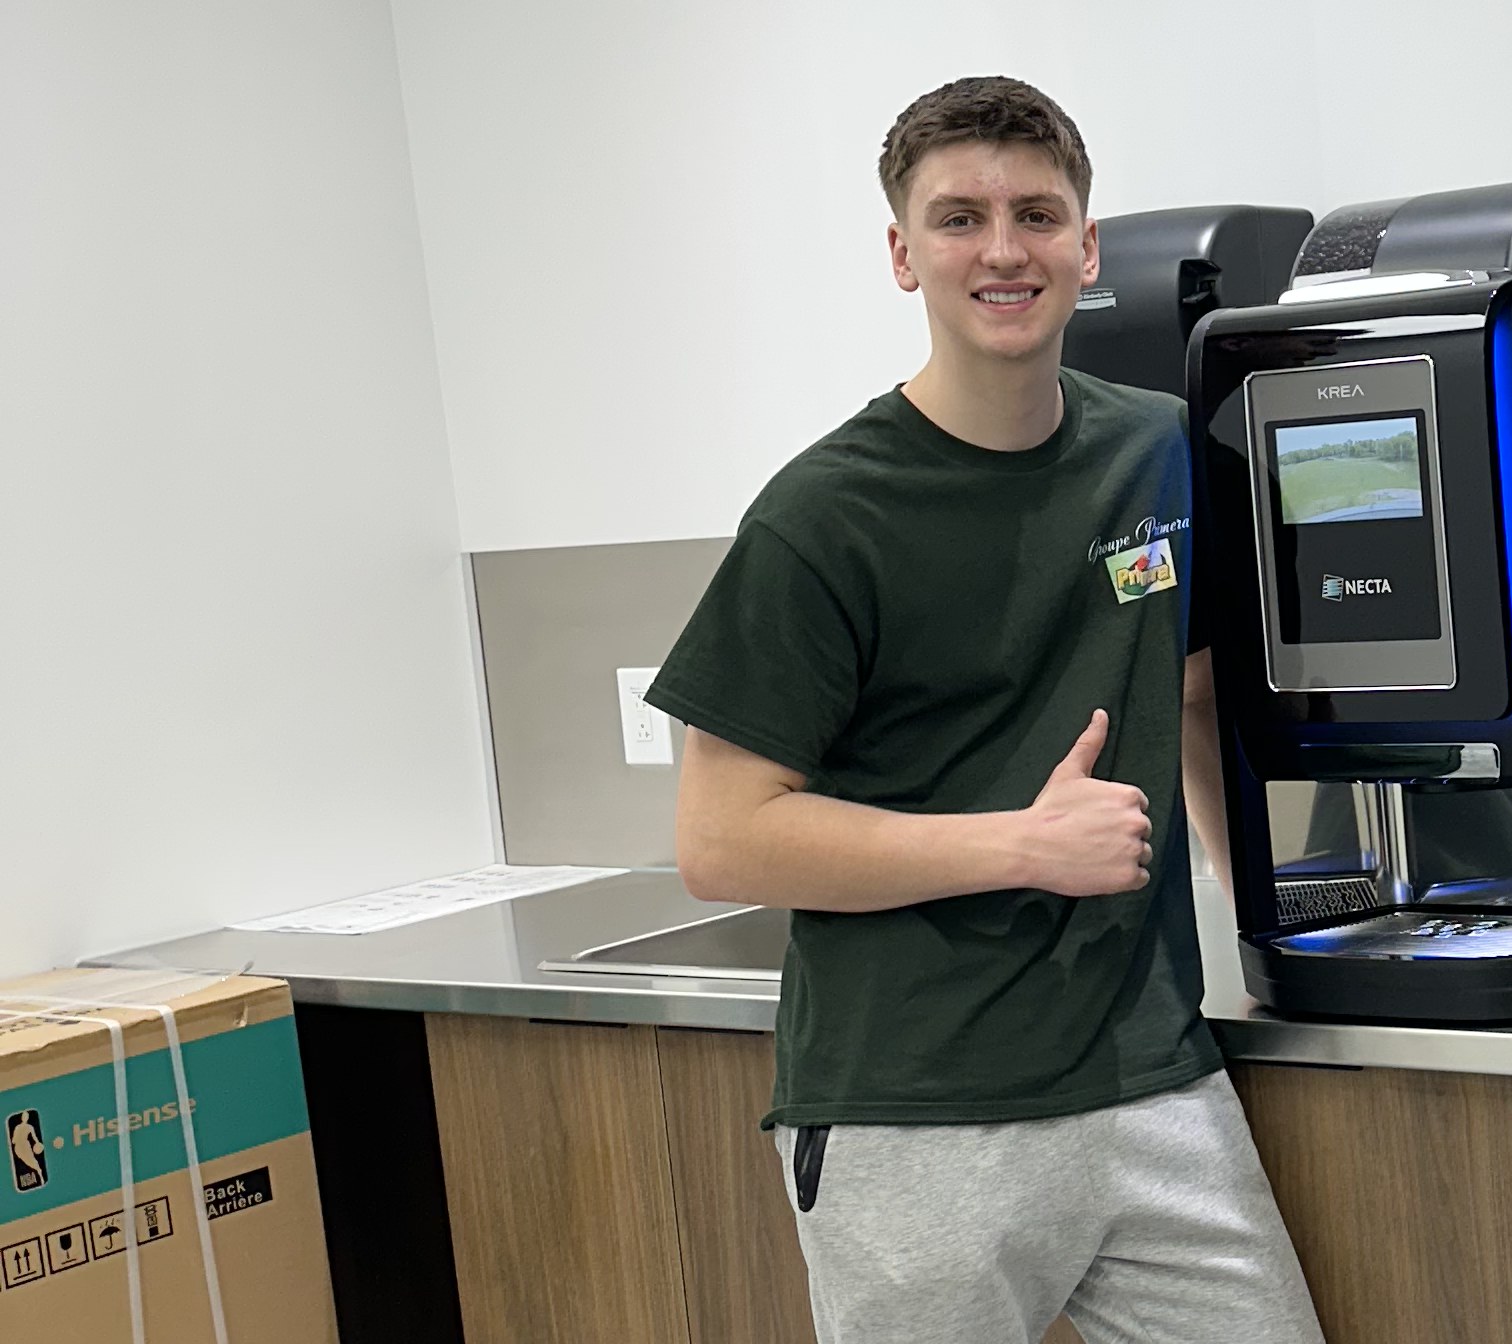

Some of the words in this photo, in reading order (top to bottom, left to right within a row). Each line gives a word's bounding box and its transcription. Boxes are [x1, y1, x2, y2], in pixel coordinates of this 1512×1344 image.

[1087, 535, 1131, 565] Groupe
[1135, 516, 1190, 546] Primera
[1345, 578, 1392, 596] NECTA
[205, 1179, 247, 1204] Back
[207, 1191, 264, 1219] Arrière
